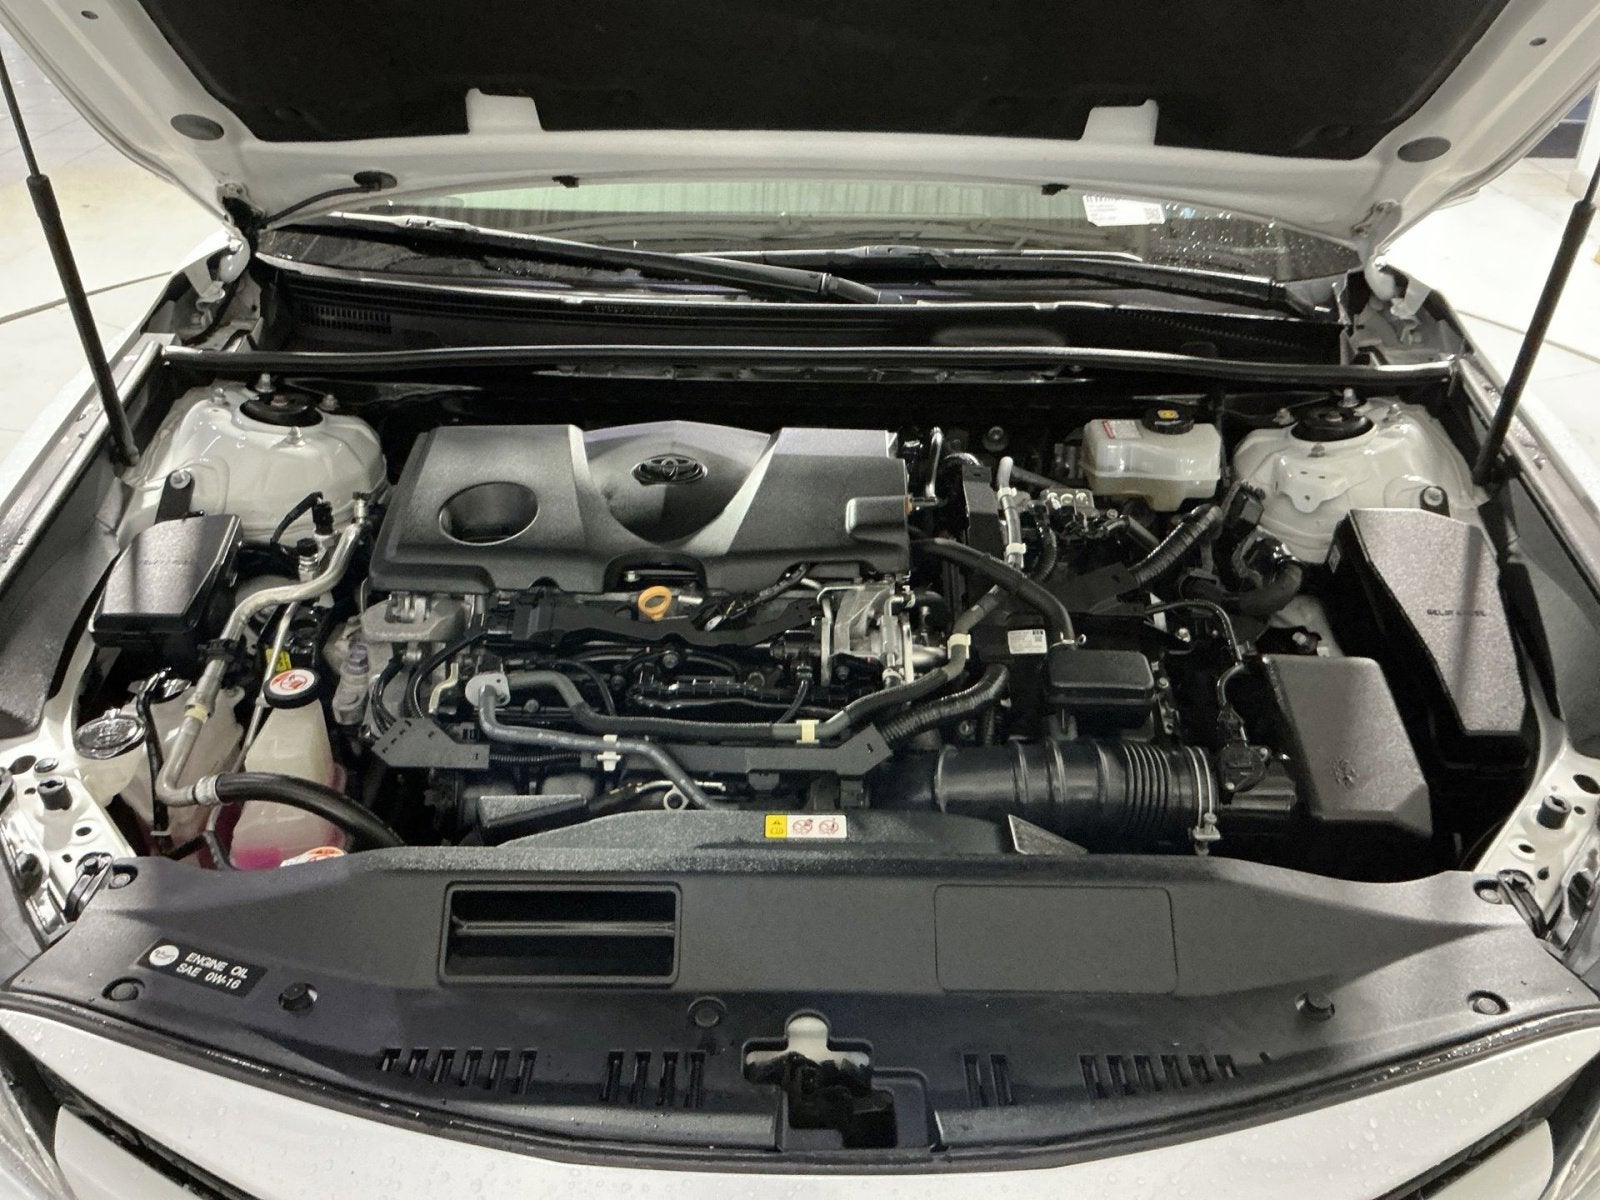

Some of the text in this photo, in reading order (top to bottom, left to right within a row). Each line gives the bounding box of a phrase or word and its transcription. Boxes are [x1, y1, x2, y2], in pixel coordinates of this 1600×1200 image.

[176, 963, 241, 989] SAE 0W-16
[185, 952, 248, 979] ENGINE OIL
